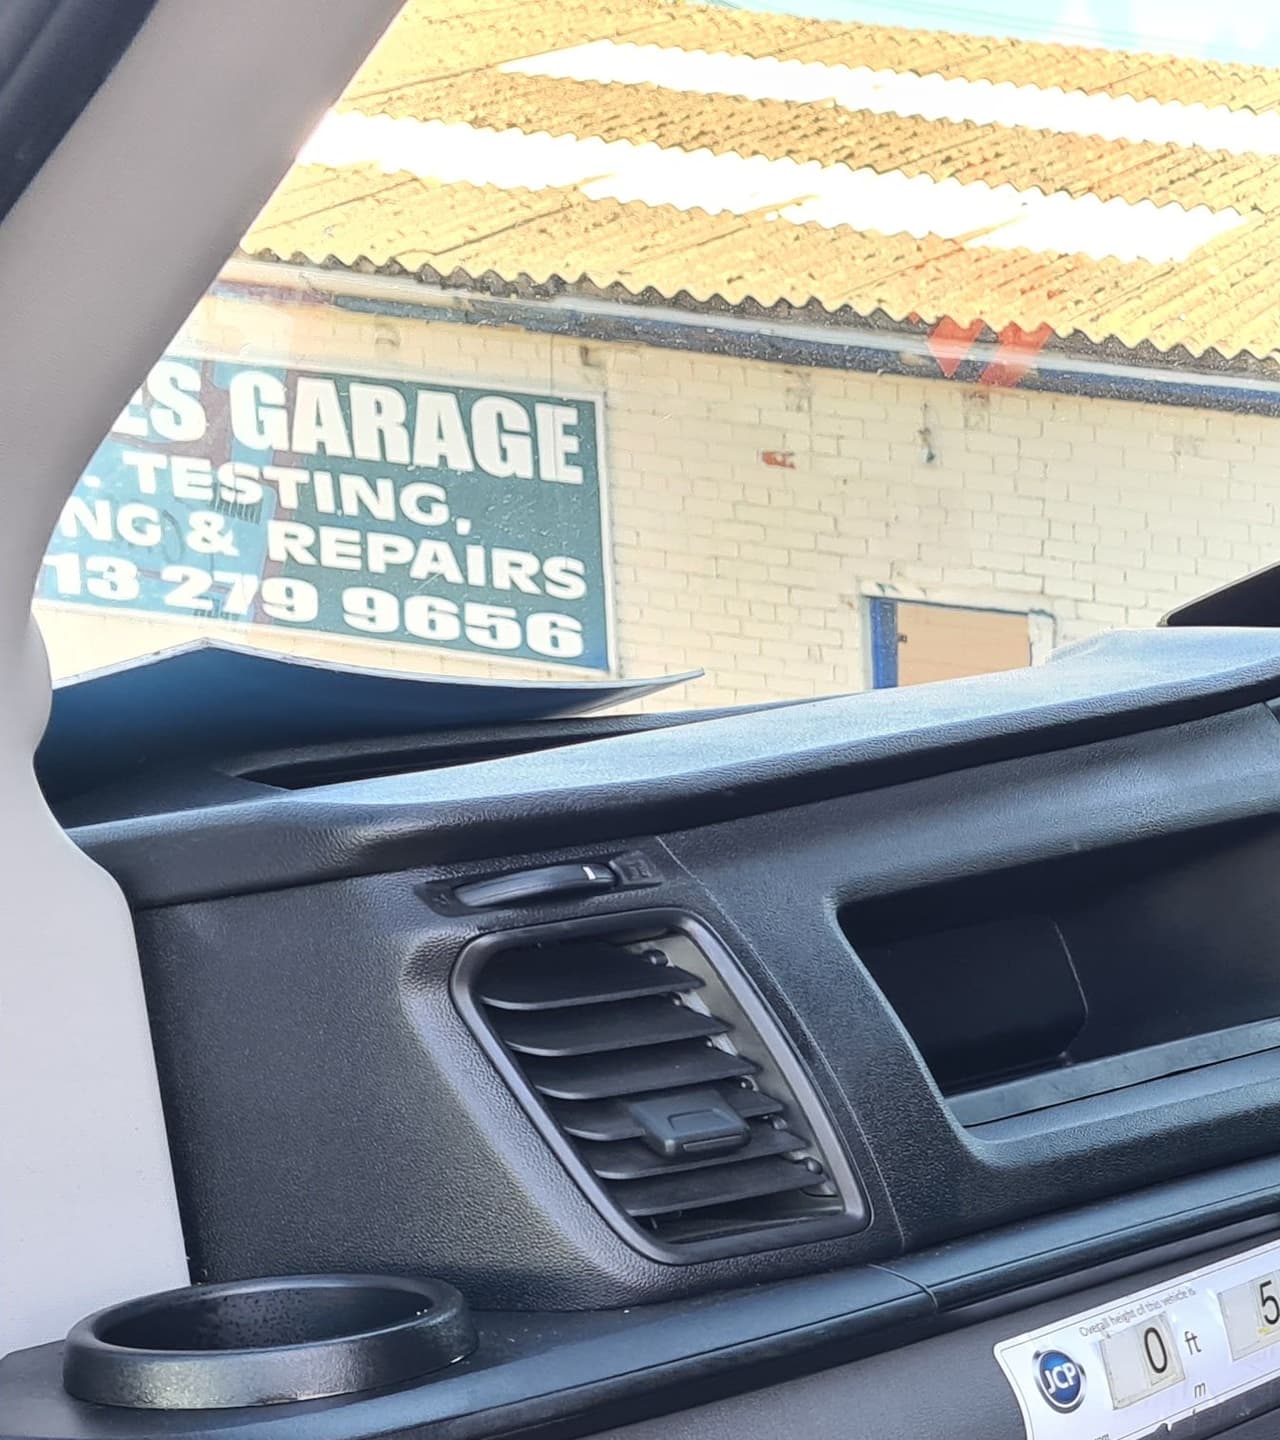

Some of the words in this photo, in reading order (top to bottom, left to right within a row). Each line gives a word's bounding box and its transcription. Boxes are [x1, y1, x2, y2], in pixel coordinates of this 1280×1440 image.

[230, 371, 583, 485] GARAGE
[122, 450, 471, 536] TESTING,
[186, 511, 240, 557] &
[267, 520, 587, 600] REPAIRS
[161, 564, 318, 622] 279
[342, 587, 585, 659] 9656
[1079, 1318, 1110, 1337] Overall
[1109, 1308, 1137, 1326] height
[1160, 1289, 1188, 1306] vehicle
[1144, 1327, 1168, 1374] 0
[1184, 1330, 1202, 1356] ft
[1258, 1280, 1280, 1325] 5
[1046, 1364, 1077, 1394] JCP
[1194, 1381, 1206, 1397] m
